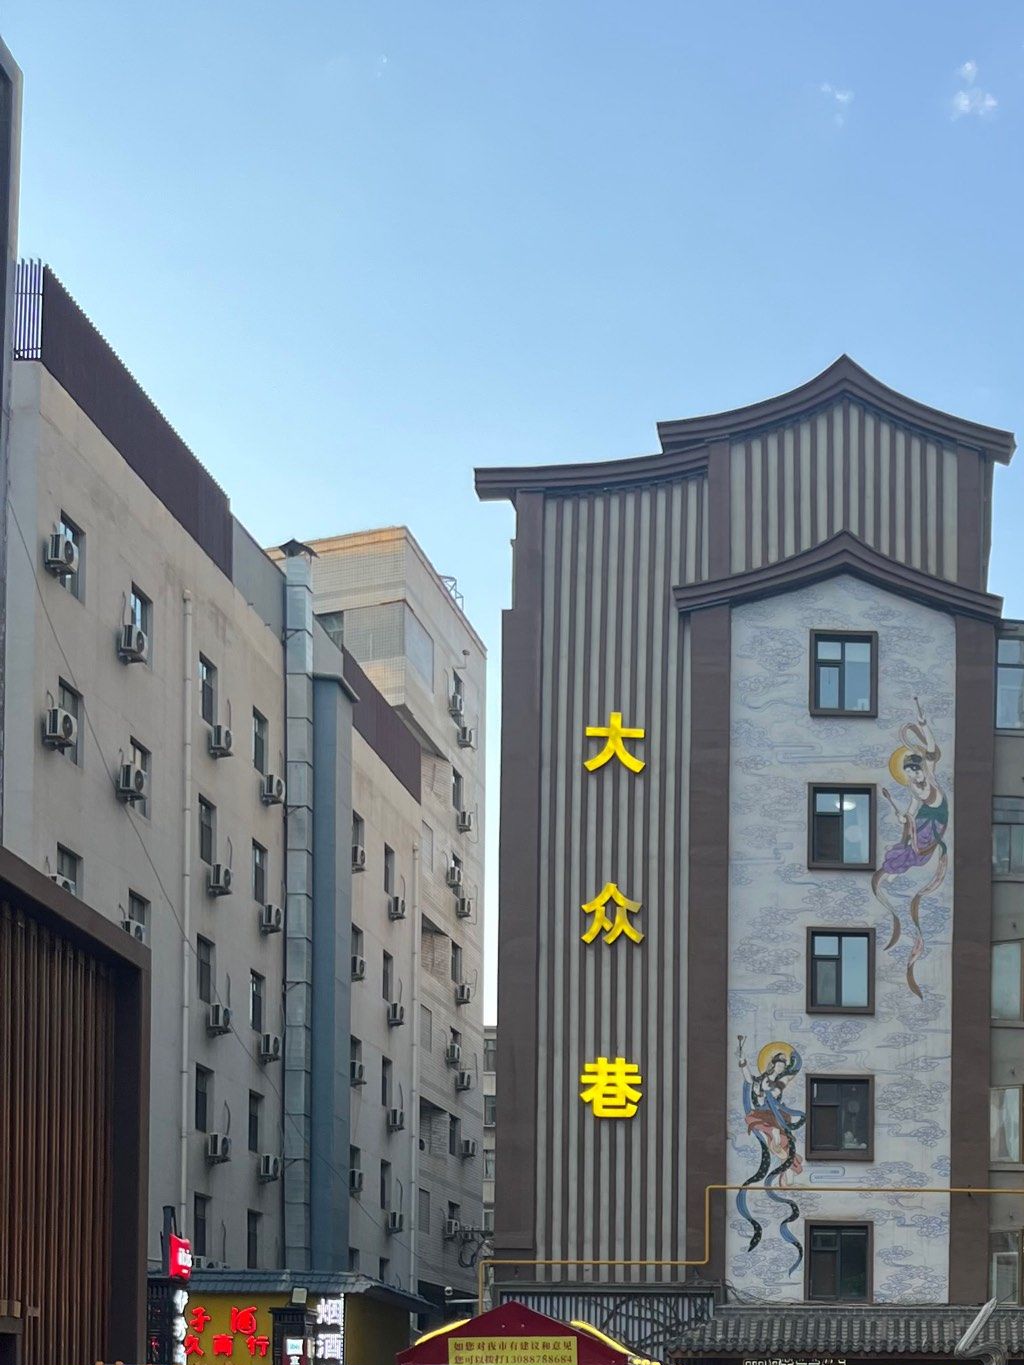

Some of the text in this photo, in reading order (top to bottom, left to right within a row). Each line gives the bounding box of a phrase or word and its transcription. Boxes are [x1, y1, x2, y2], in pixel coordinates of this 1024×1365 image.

[580, 711, 646, 1118] 大众巷
[454, 1340, 572, 1351] 如您对夜市有建议和意见
